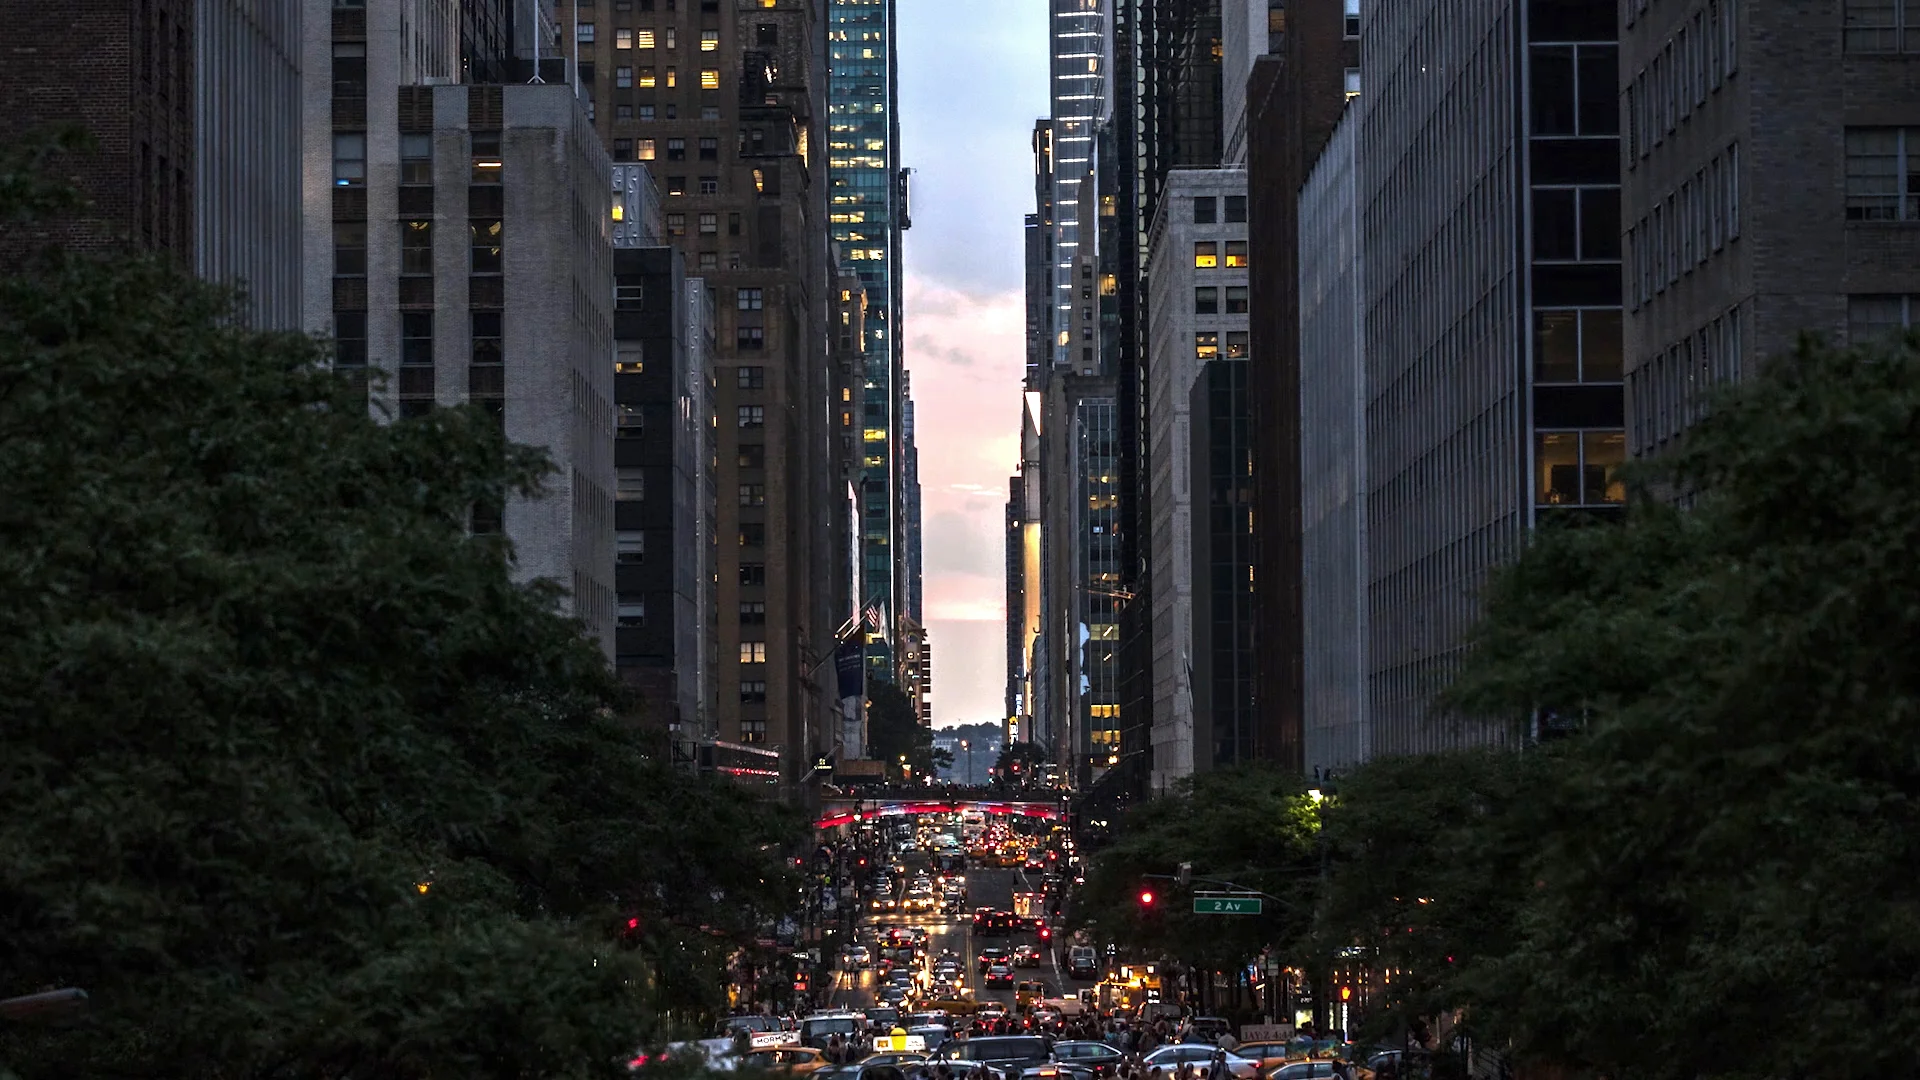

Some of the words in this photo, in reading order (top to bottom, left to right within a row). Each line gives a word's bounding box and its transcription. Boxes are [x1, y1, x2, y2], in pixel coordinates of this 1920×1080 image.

[1214, 901, 1222, 911] 2
[1225, 901, 1241, 911] Av
[756, 1033, 794, 1045] MORMON
